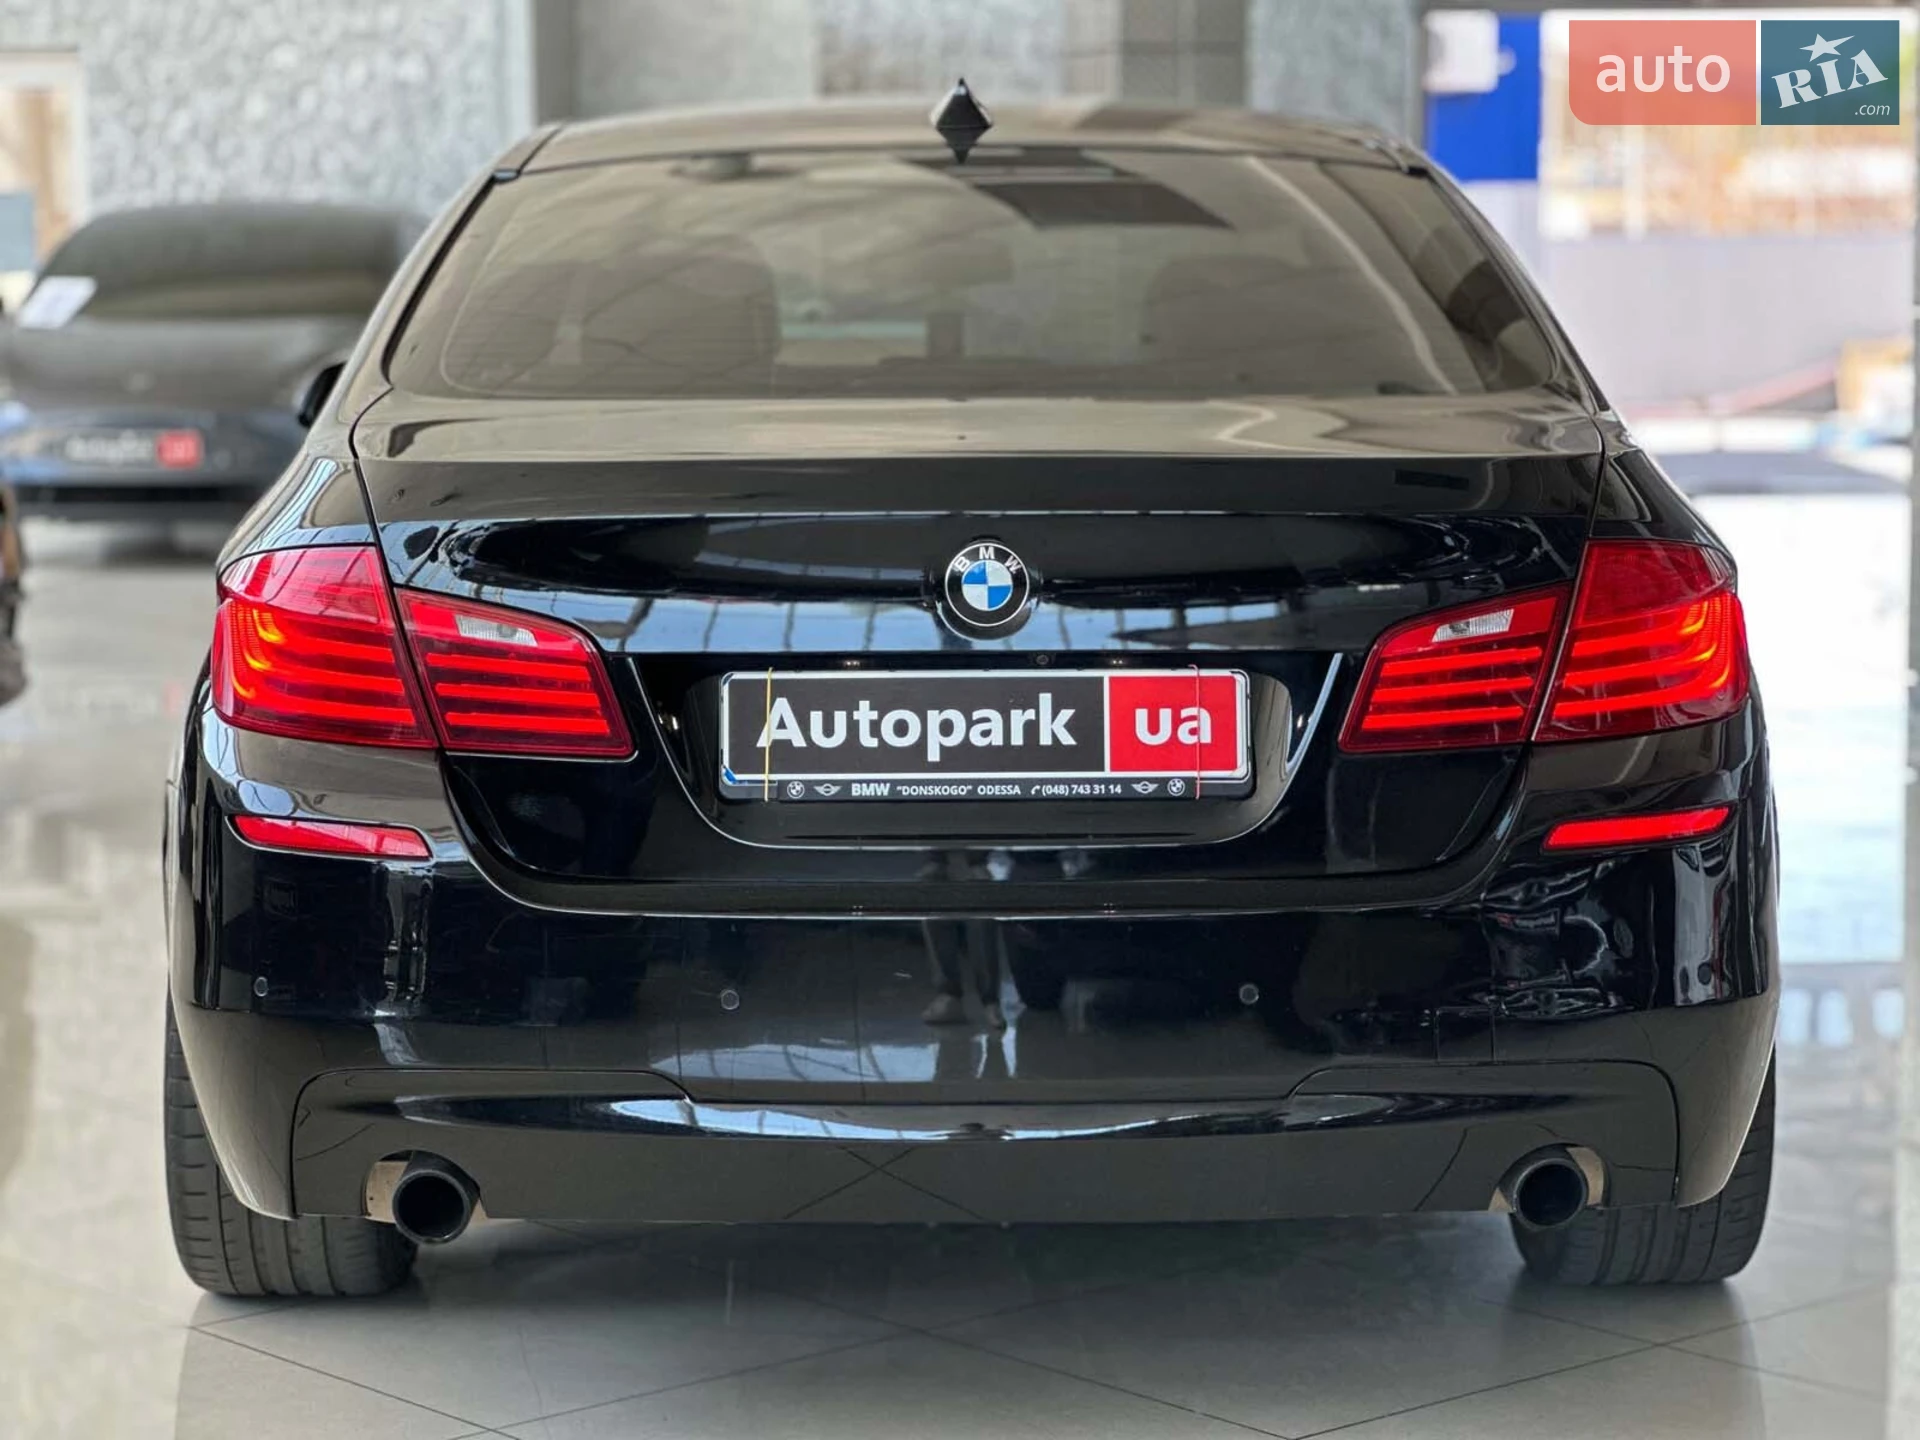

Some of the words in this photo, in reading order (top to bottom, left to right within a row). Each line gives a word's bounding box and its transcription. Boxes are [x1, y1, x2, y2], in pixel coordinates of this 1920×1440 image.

[952, 546, 1022, 574] BMW
[756, 693, 1077, 762] Autopark
[1134, 705, 1212, 745] ua
[851, 783, 890, 796] BMW
[977, 785, 1021, 795] ODESSA
[1041, 784, 1069, 796] (048)
[1071, 784, 1091, 795] 743
[1093, 784, 1105, 795] 31
[1108, 784, 1122, 794] 14
